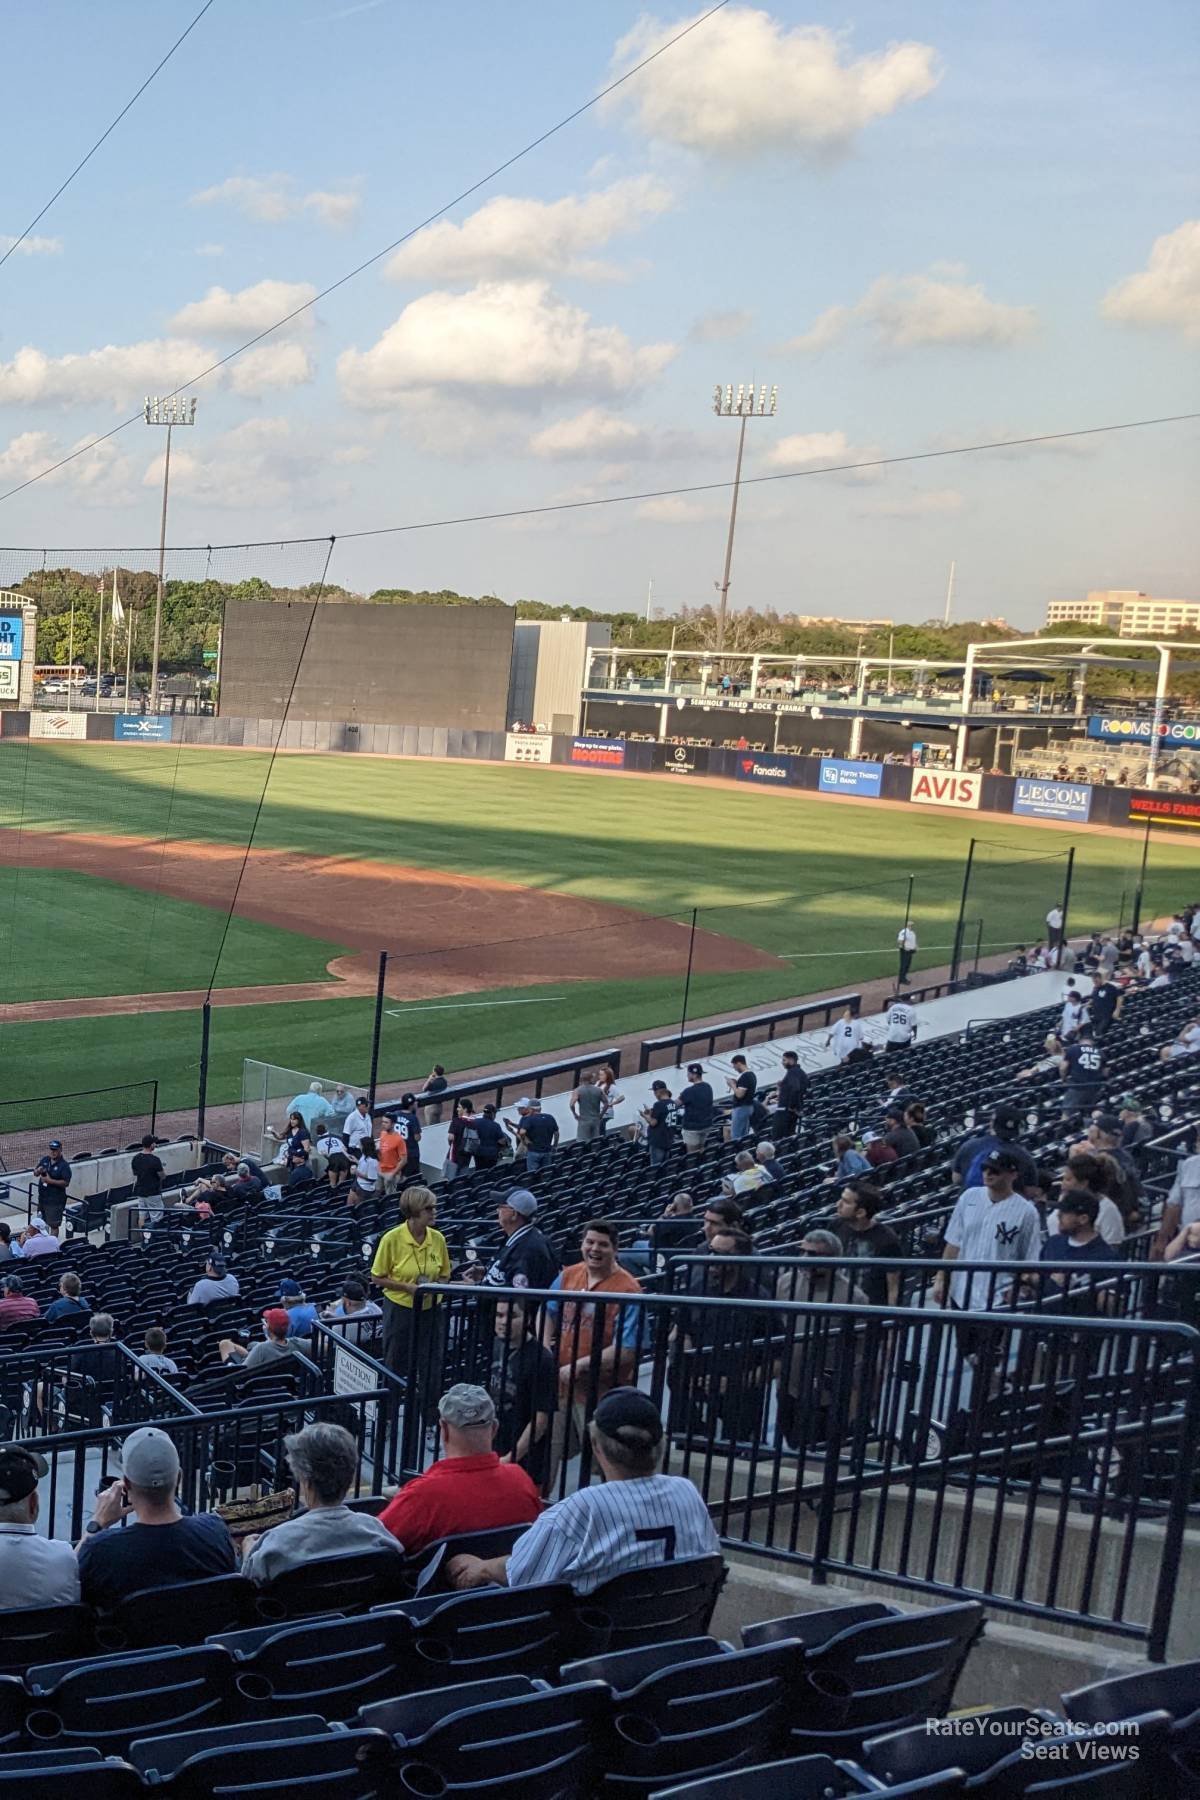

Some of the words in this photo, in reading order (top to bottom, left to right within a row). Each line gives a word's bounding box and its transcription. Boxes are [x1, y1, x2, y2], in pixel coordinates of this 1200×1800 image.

[690, 698, 723, 707] SEMINOLE
[728, 700, 748, 708] HARD
[752, 702, 772, 710] ROCK
[777, 703, 806, 712] CABANAS
[1101, 720, 1151, 735] ROOMS
[1171, 725, 1195, 740] GO
[572, 749, 624, 765] HOOTERS
[753, 764, 787, 778] Fanatics
[840, 769, 857, 778] FIFTH
[859, 771, 879, 780] THIRD
[913, 775, 974, 802] AVIS
[1131, 799, 1170, 813] WELLS
[892, 1013, 907, 1025] 26
[844, 1026, 853, 1037] 2
[1078, 1053, 1101, 1070] 45
[665, 1111, 677, 1127] 45
[393, 1123, 409, 1140] 99
[340, 1357, 371, 1384] CAUTION
[635, 1525, 676, 1561] 7
